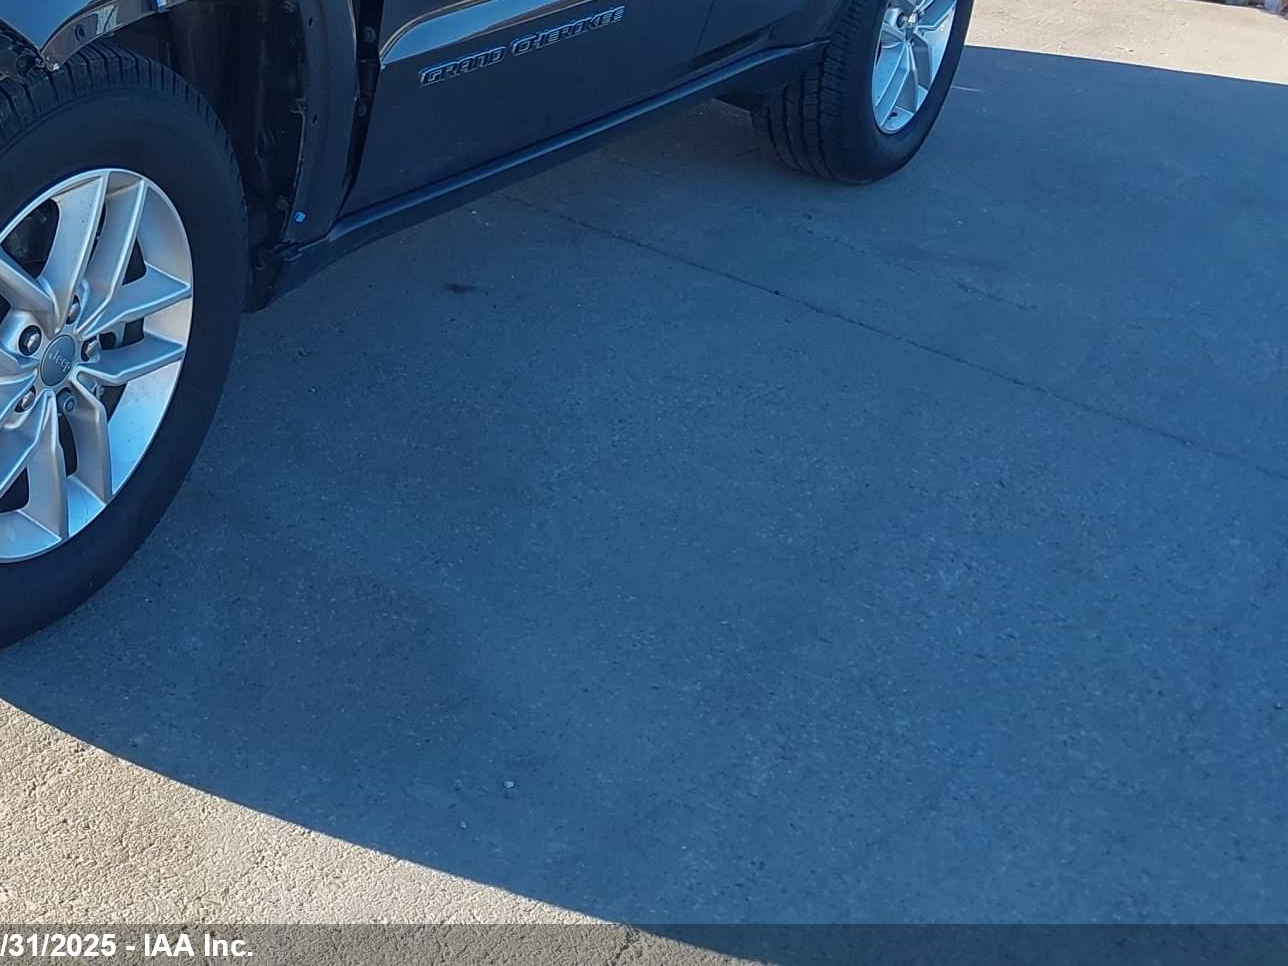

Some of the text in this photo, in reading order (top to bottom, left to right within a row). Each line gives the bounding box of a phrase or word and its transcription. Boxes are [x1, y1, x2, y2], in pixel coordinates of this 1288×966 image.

[418, 5, 626, 86] GRAND CHEROKEE
[48, 349, 73, 373] Jeep
